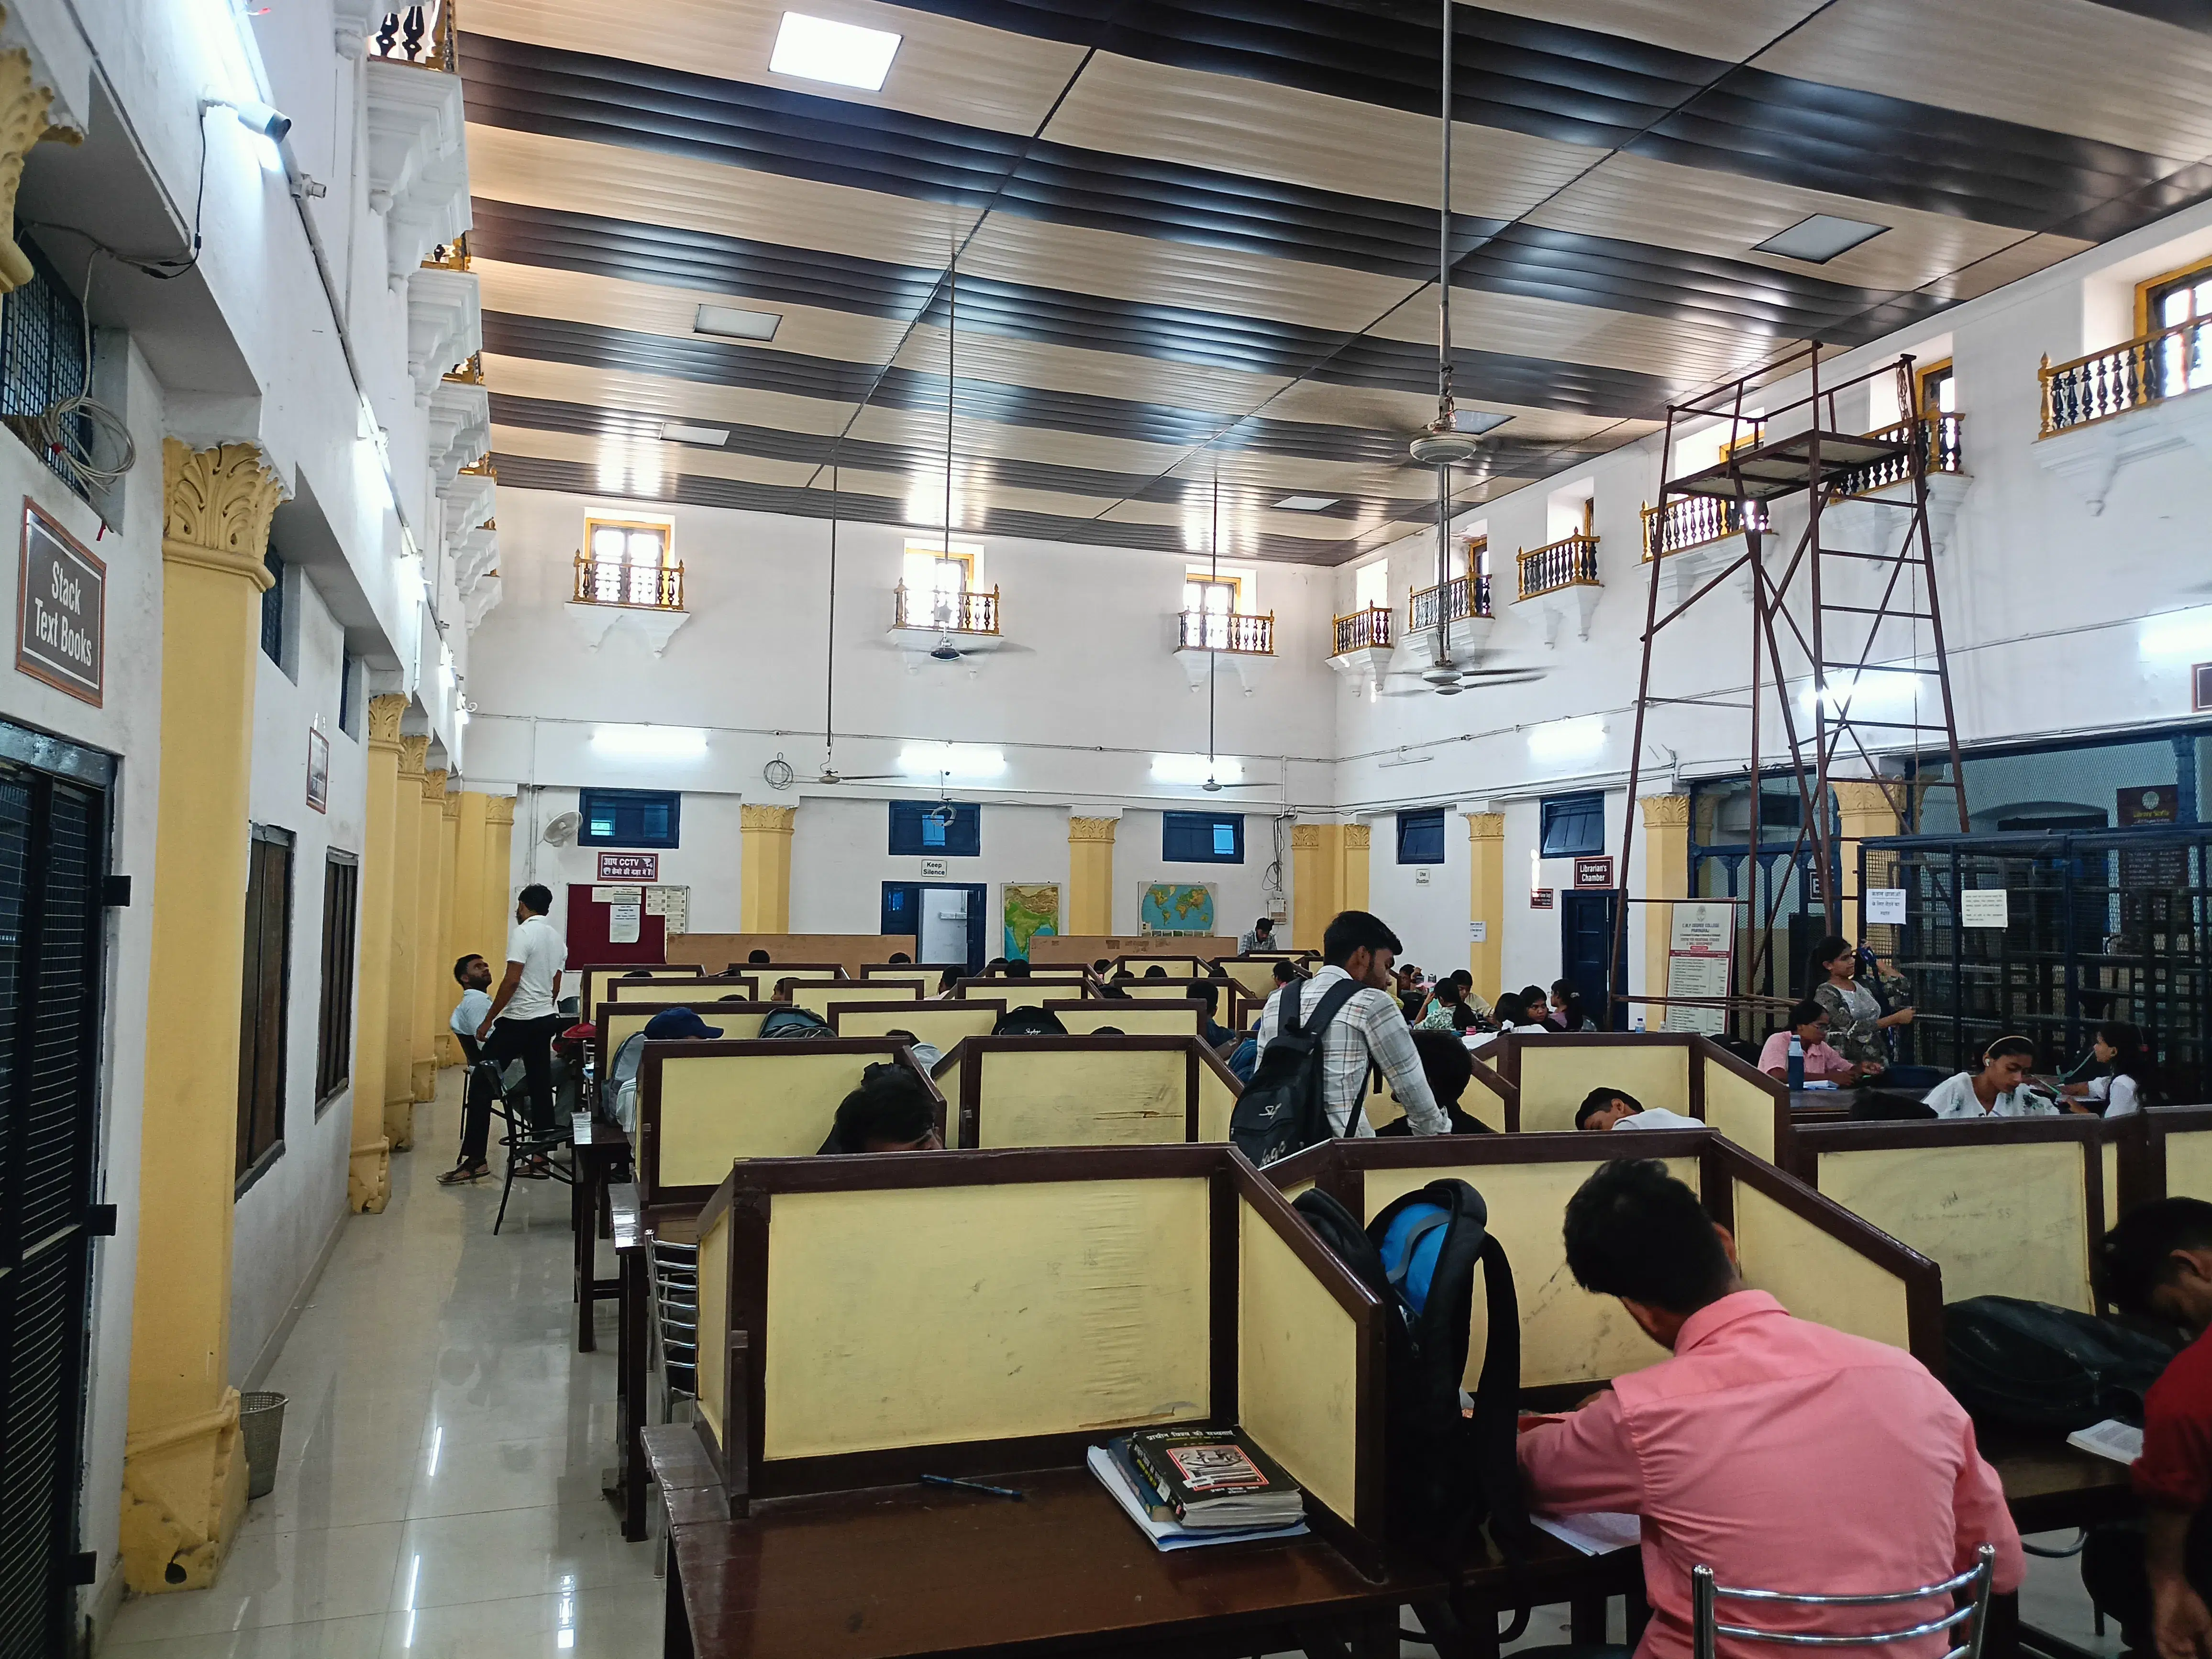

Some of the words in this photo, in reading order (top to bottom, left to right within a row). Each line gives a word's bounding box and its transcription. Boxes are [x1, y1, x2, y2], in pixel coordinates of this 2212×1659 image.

[52, 561, 81, 615] Stack
[35, 597, 58, 647] Text
[61, 615, 91, 666] Books
[1580, 863, 1607, 873] Librarian's
[1582, 874, 1605, 882] Chamber
